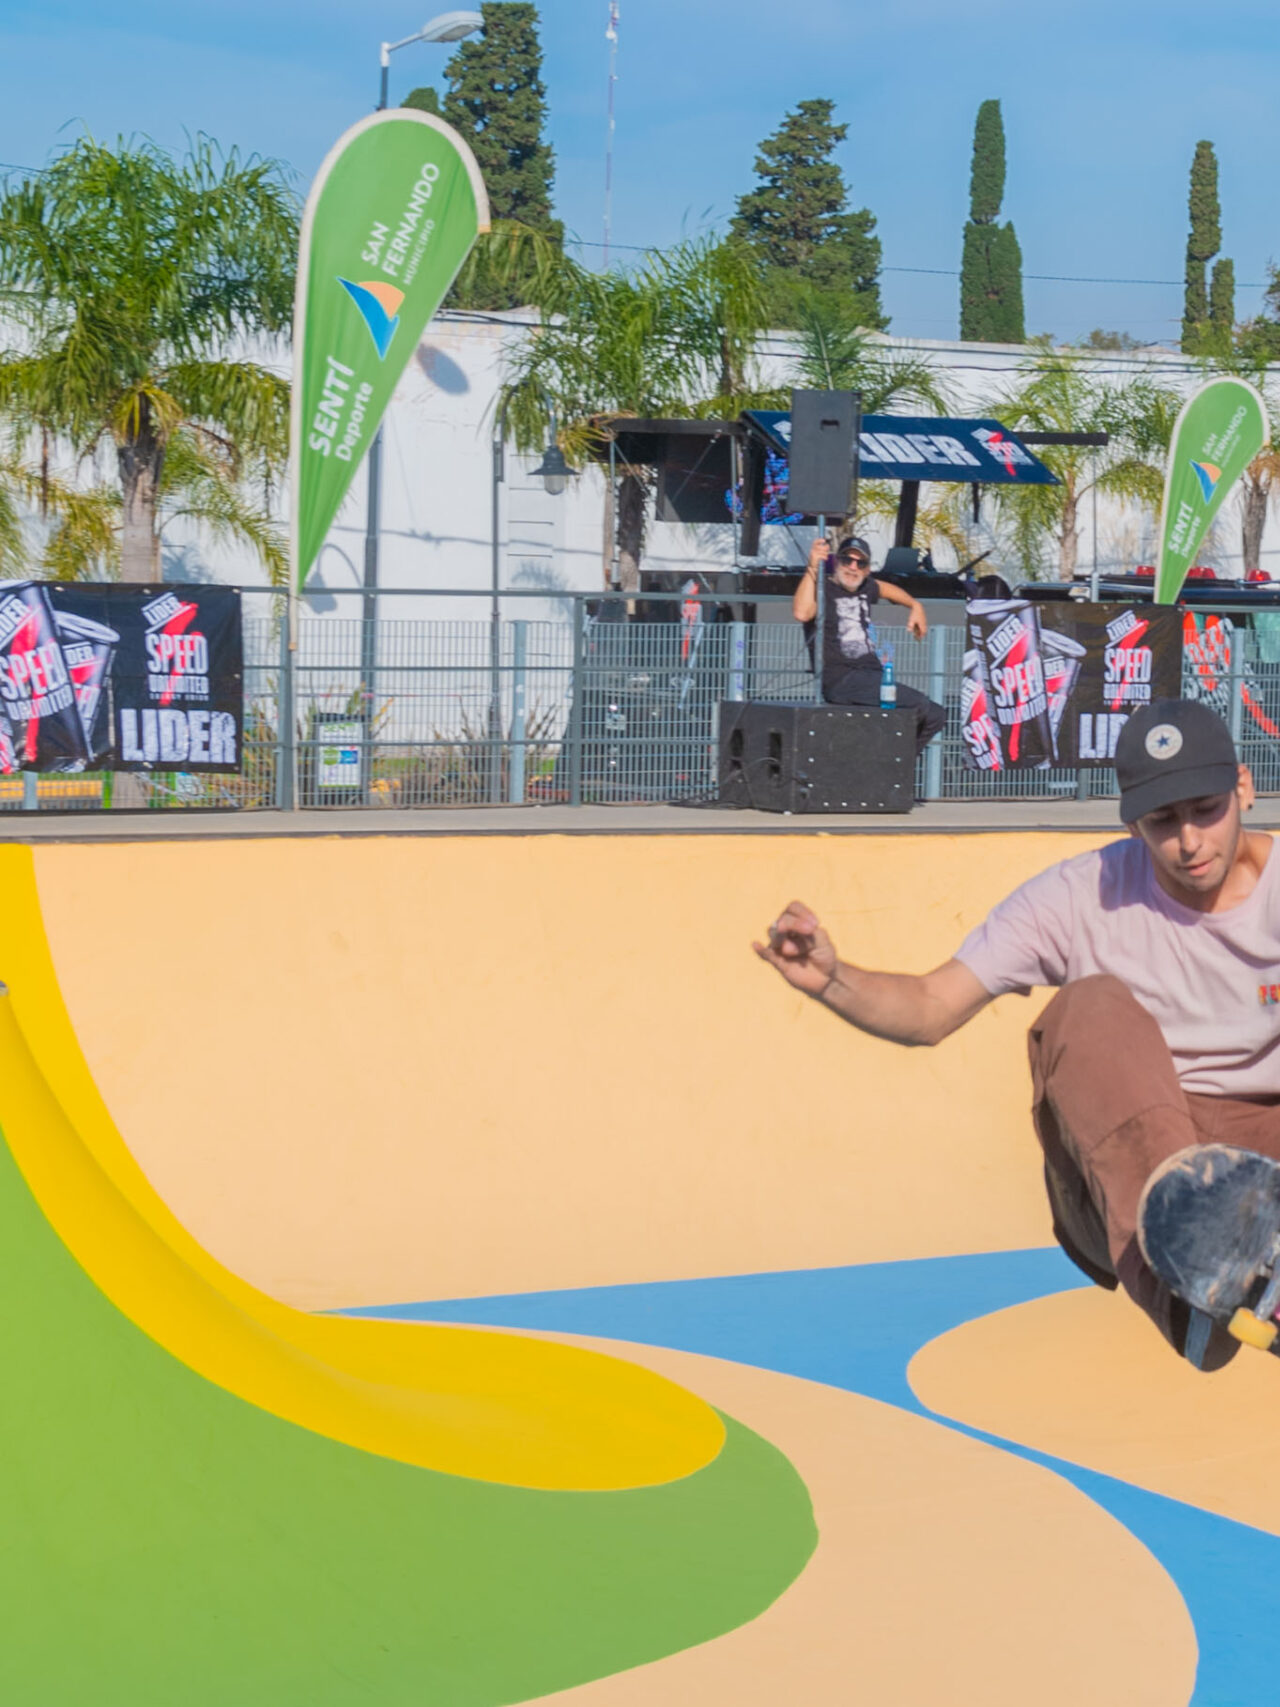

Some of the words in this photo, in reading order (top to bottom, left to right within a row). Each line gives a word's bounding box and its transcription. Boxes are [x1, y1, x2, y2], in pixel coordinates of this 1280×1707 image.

[381, 163, 440, 277] FERNANDO
[361, 221, 390, 266] SAN
[403, 219, 435, 285] MUNICIPIO
[335, 382, 374, 461] Deporte
[987, 617, 1024, 660] LIDER
[1106, 612, 1137, 642] LIDER
[145, 633, 209, 674] SPEED
[1104, 648, 1152, 683] SPEED
[120, 708, 236, 764] LIDER
